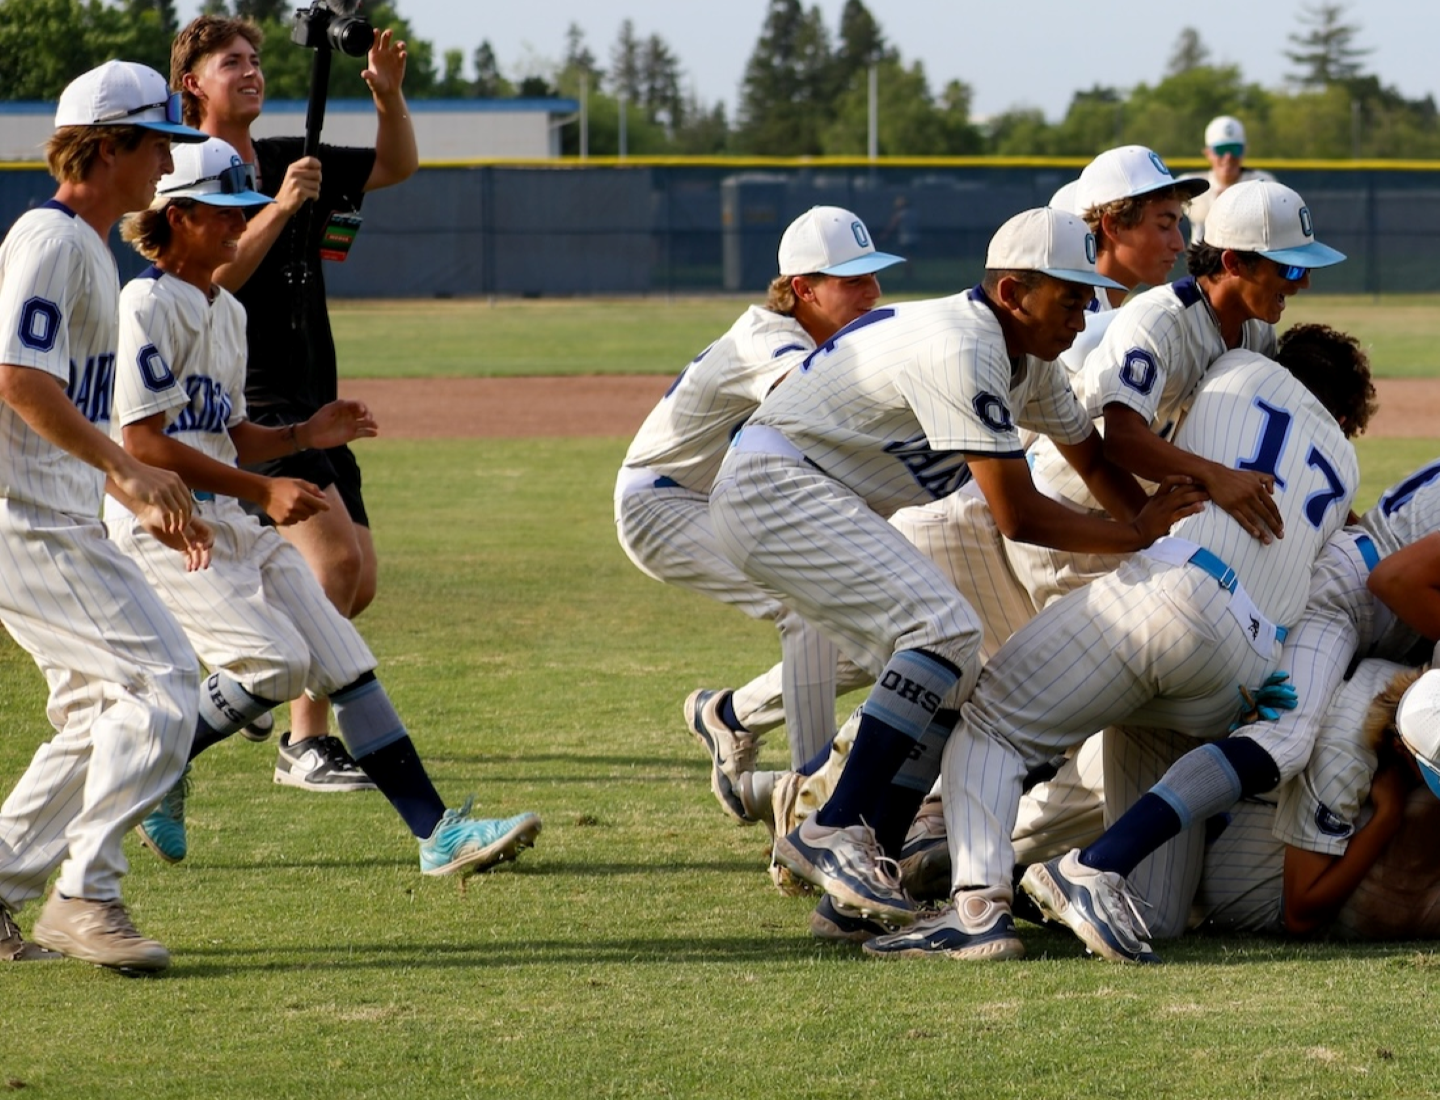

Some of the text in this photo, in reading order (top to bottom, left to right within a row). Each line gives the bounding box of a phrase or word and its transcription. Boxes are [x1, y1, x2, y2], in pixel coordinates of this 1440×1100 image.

[1149, 151, 1170, 175] O
[851, 220, 869, 248] O
[1299, 206, 1314, 237] O
[1084, 233, 1096, 264] O
[18, 296, 62, 352] O
[136, 343, 176, 393] O
[1119, 346, 1158, 396] O
[972, 390, 1014, 434] O
[1233, 395, 1347, 531] 17
[207, 672, 246, 722] OHS
[880, 669, 943, 715] OHS
